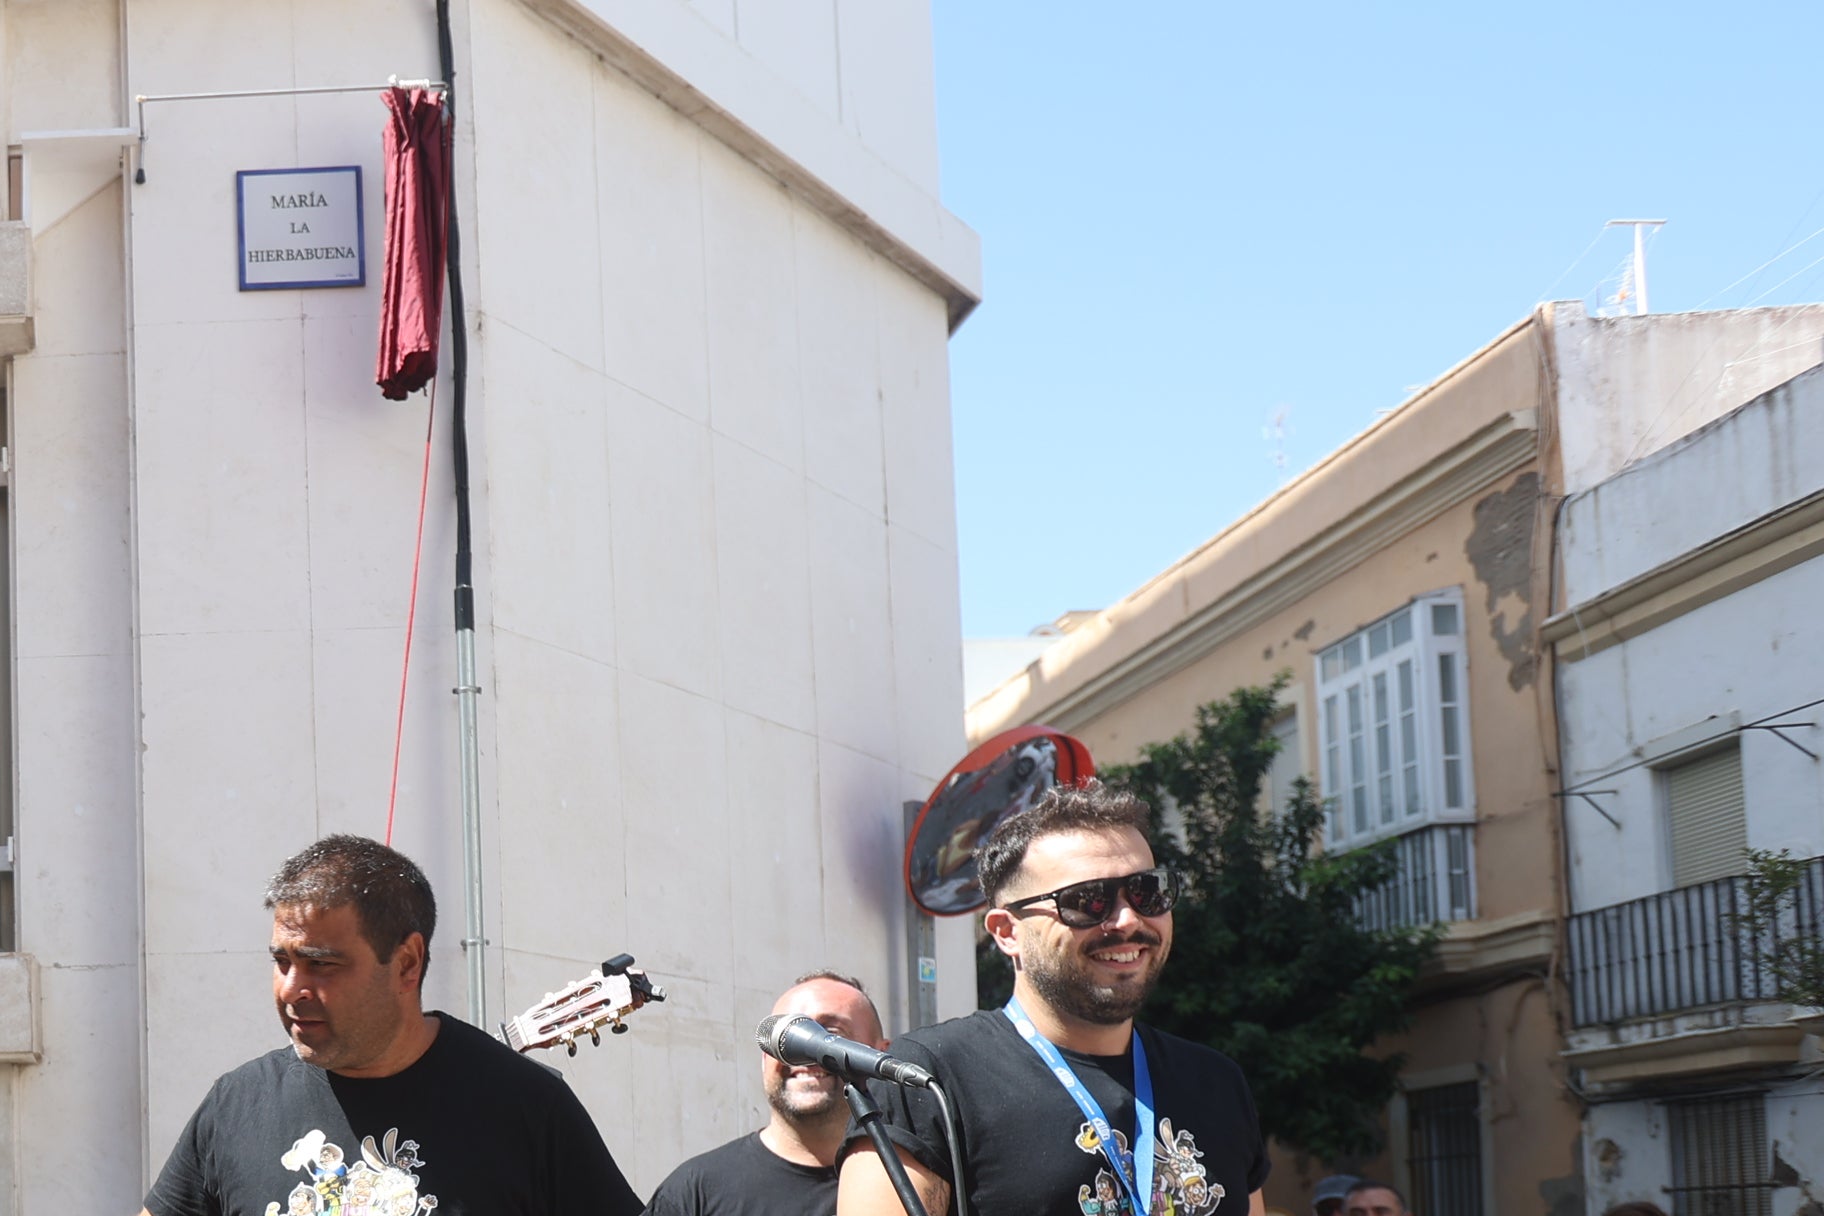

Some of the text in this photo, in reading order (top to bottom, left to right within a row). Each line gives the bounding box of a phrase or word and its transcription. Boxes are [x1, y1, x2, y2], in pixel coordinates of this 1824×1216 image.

[271, 191, 328, 209] MARÍA
[290, 222, 310, 234] LA
[248, 246, 355, 263] HIERBABUENA
